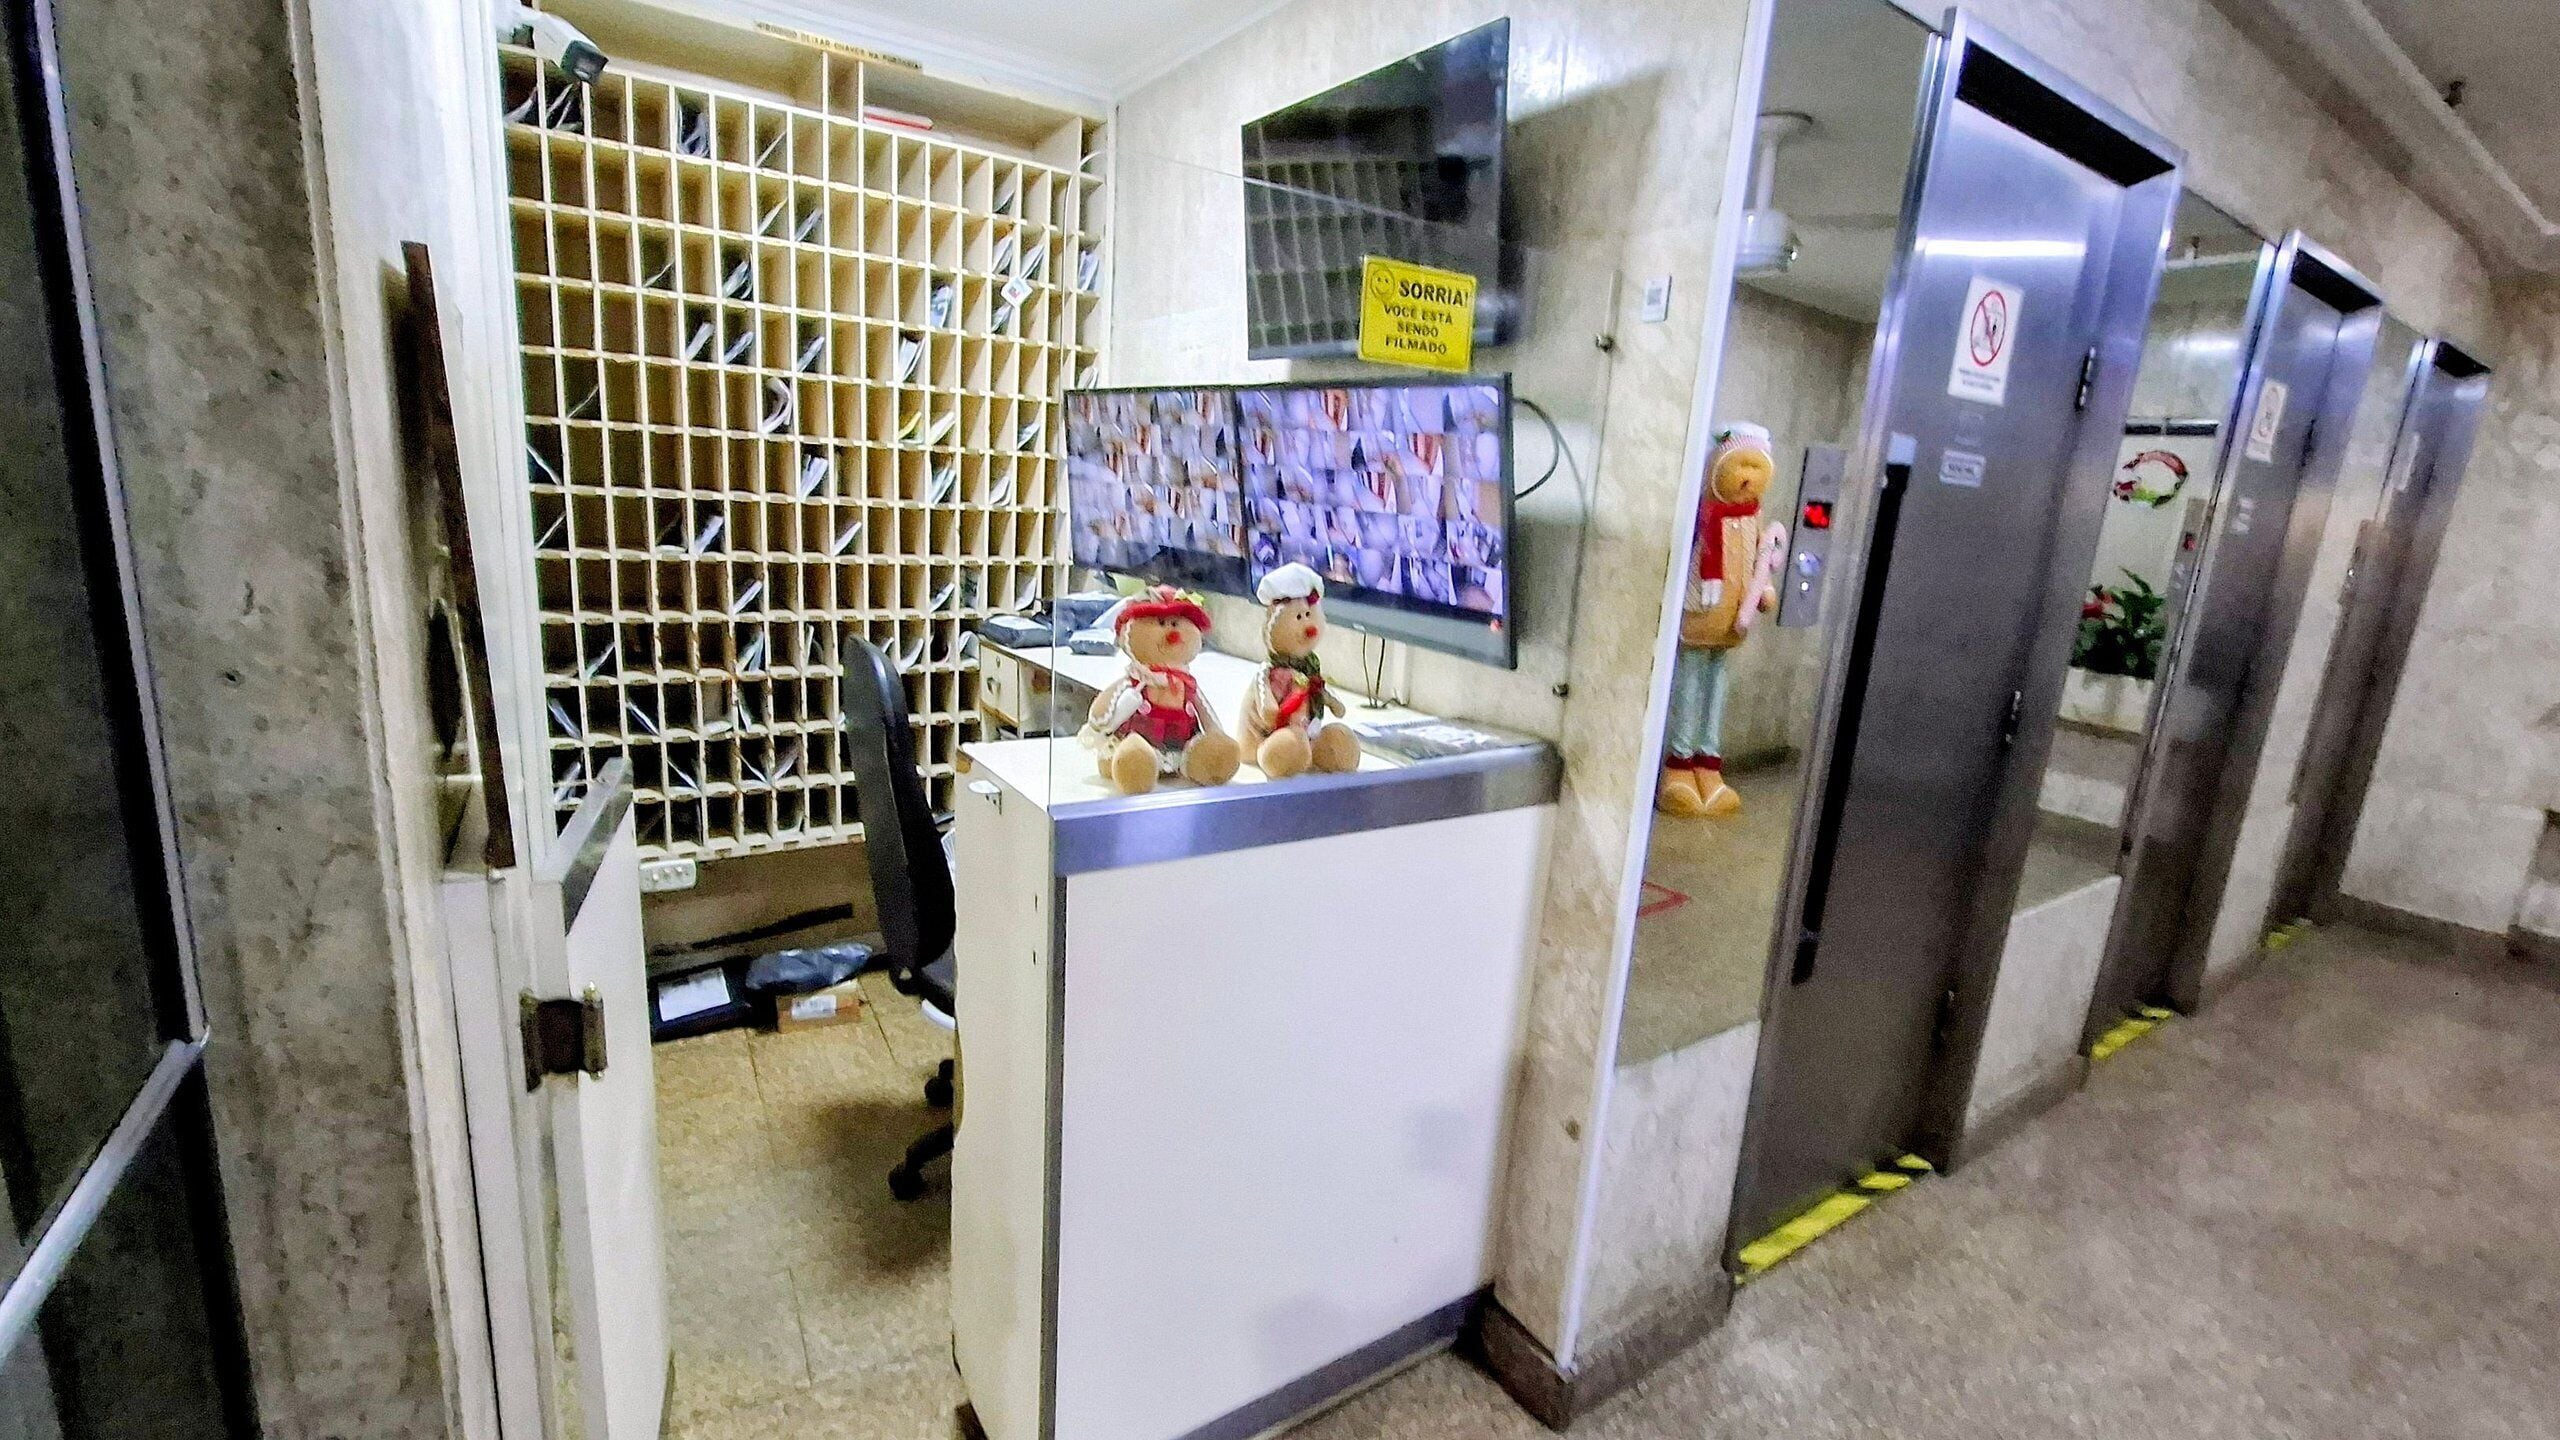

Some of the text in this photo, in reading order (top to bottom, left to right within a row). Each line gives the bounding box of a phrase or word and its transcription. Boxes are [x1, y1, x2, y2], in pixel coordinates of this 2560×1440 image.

[1399, 279, 1469, 307] SORRIA!
[1397, 321, 1439, 338] SENDO
[1385, 335, 1447, 355] FILMADO
